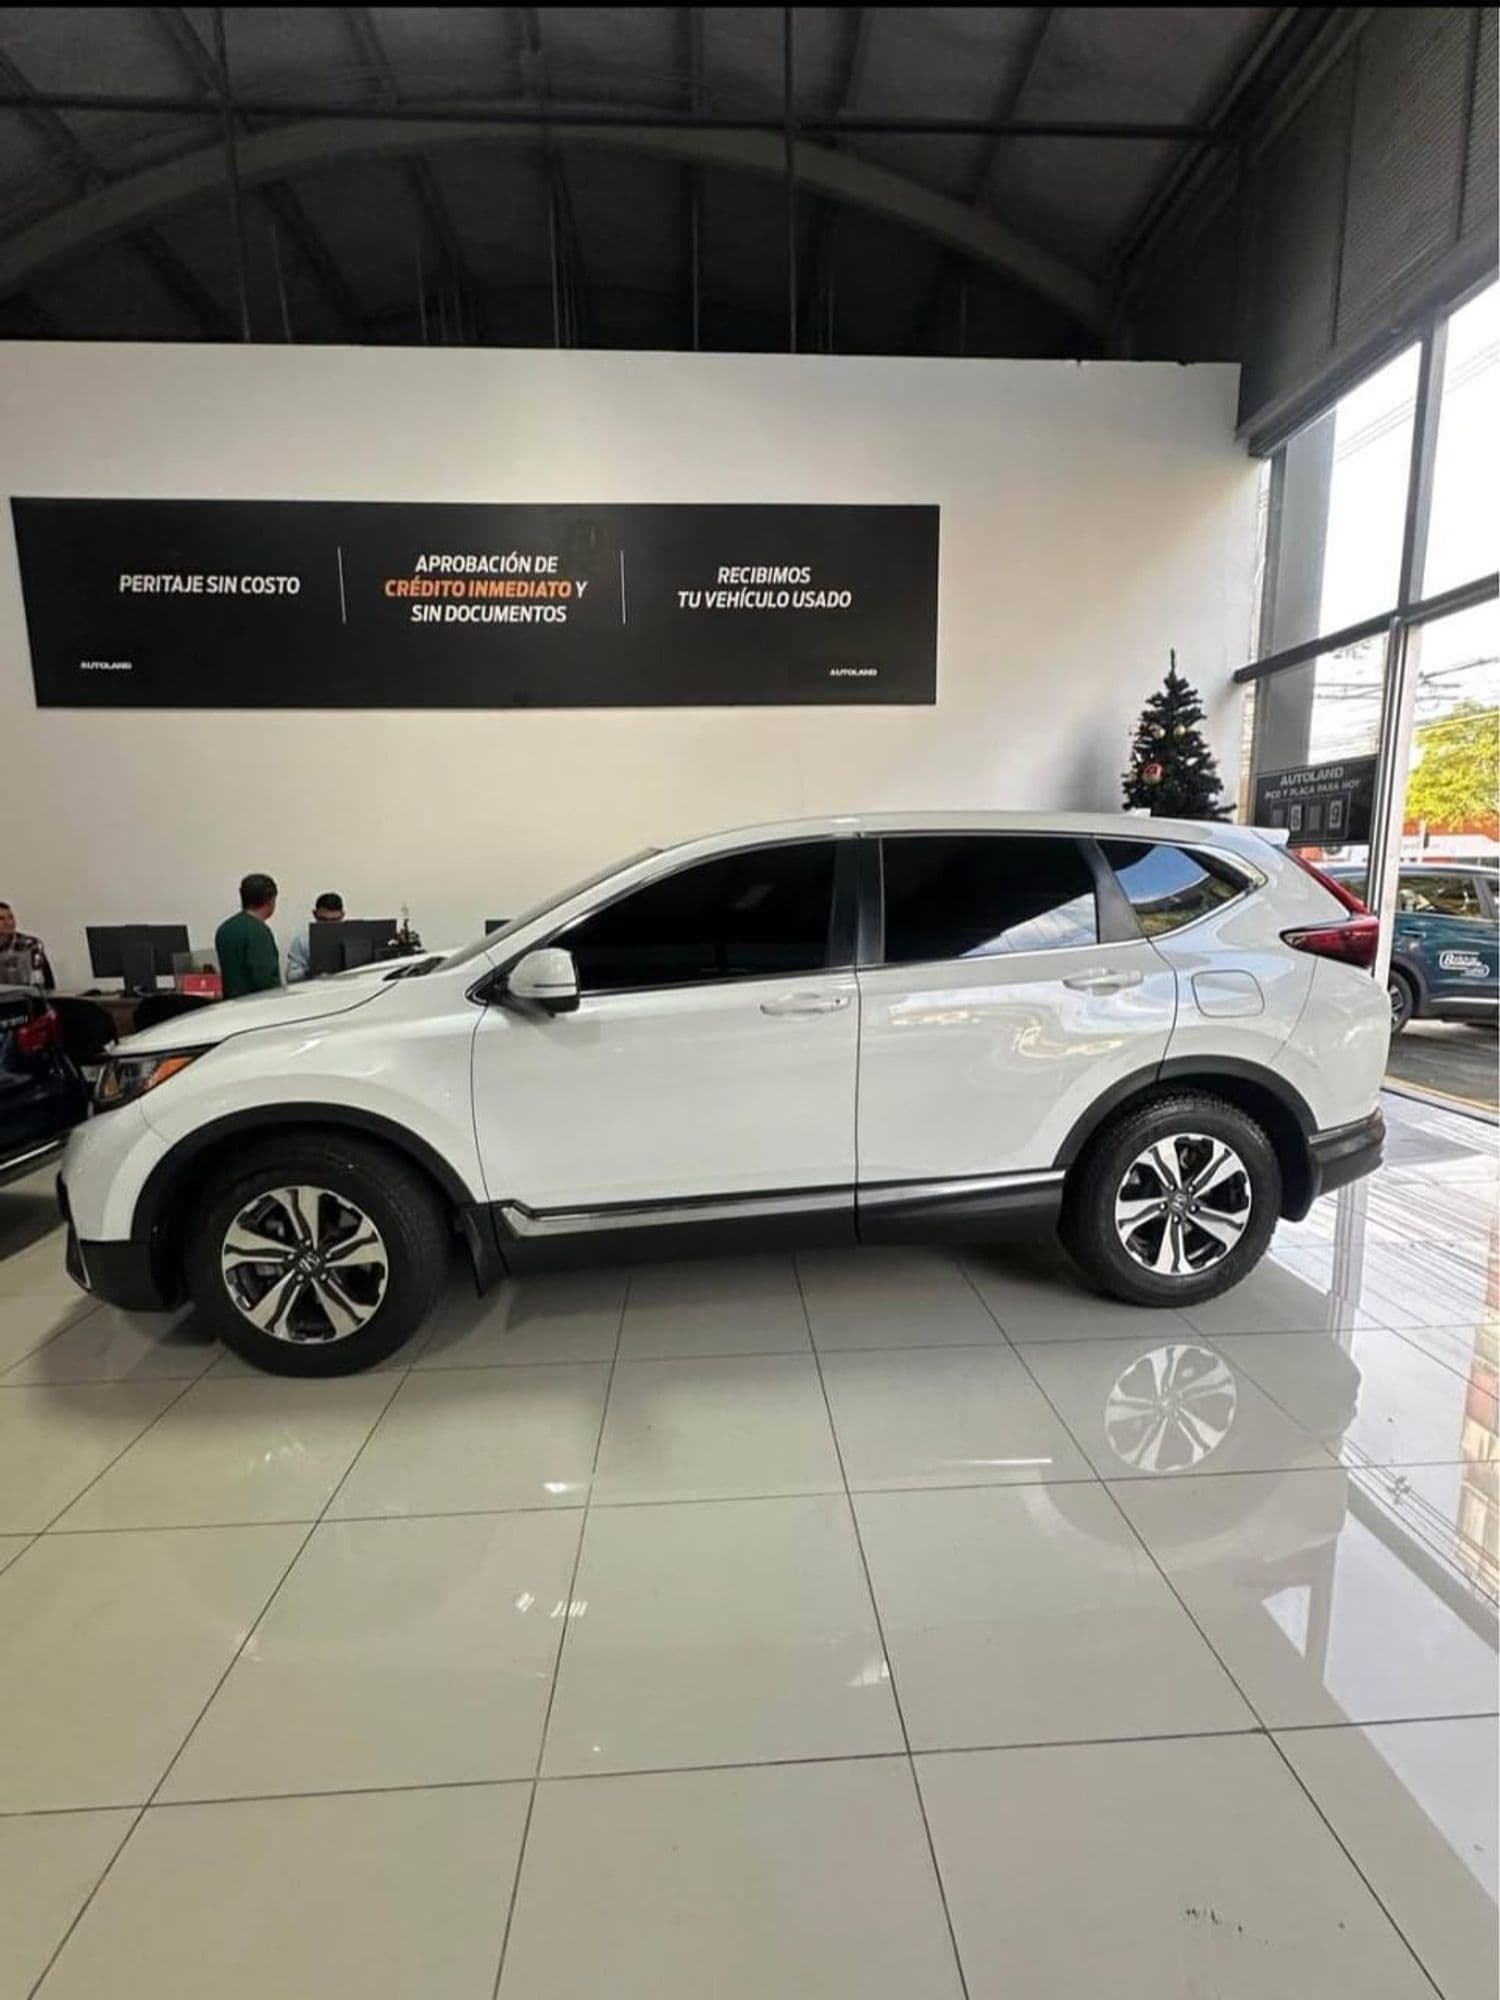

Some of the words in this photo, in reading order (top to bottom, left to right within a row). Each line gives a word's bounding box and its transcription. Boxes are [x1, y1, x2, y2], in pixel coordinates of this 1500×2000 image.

[415, 551, 531, 573] APROBACIÓN
[534, 556, 558, 573] DE
[119, 574, 203, 592] PERITAJE
[206, 576, 237, 593] SIN
[241, 576, 300, 594] COSTO
[717, 566, 811, 584] RECIBIMOS
[385, 576, 465, 597] CRÉDITO
[467, 580, 571, 598] INMEDIATO
[575, 581, 588, 598] Y
[678, 591, 700, 608] TU
[705, 587, 789, 608] VEHÍCULO
[793, 591, 852, 608] USADO
[411, 605, 442, 622] SIN
[444, 605, 567, 623] DOCUMENTOS
[80, 661, 133, 670] AUTOLAND
[829, 668, 878, 677] AUTOLAND
[1280, 767, 1343, 786] AUTOLAND
